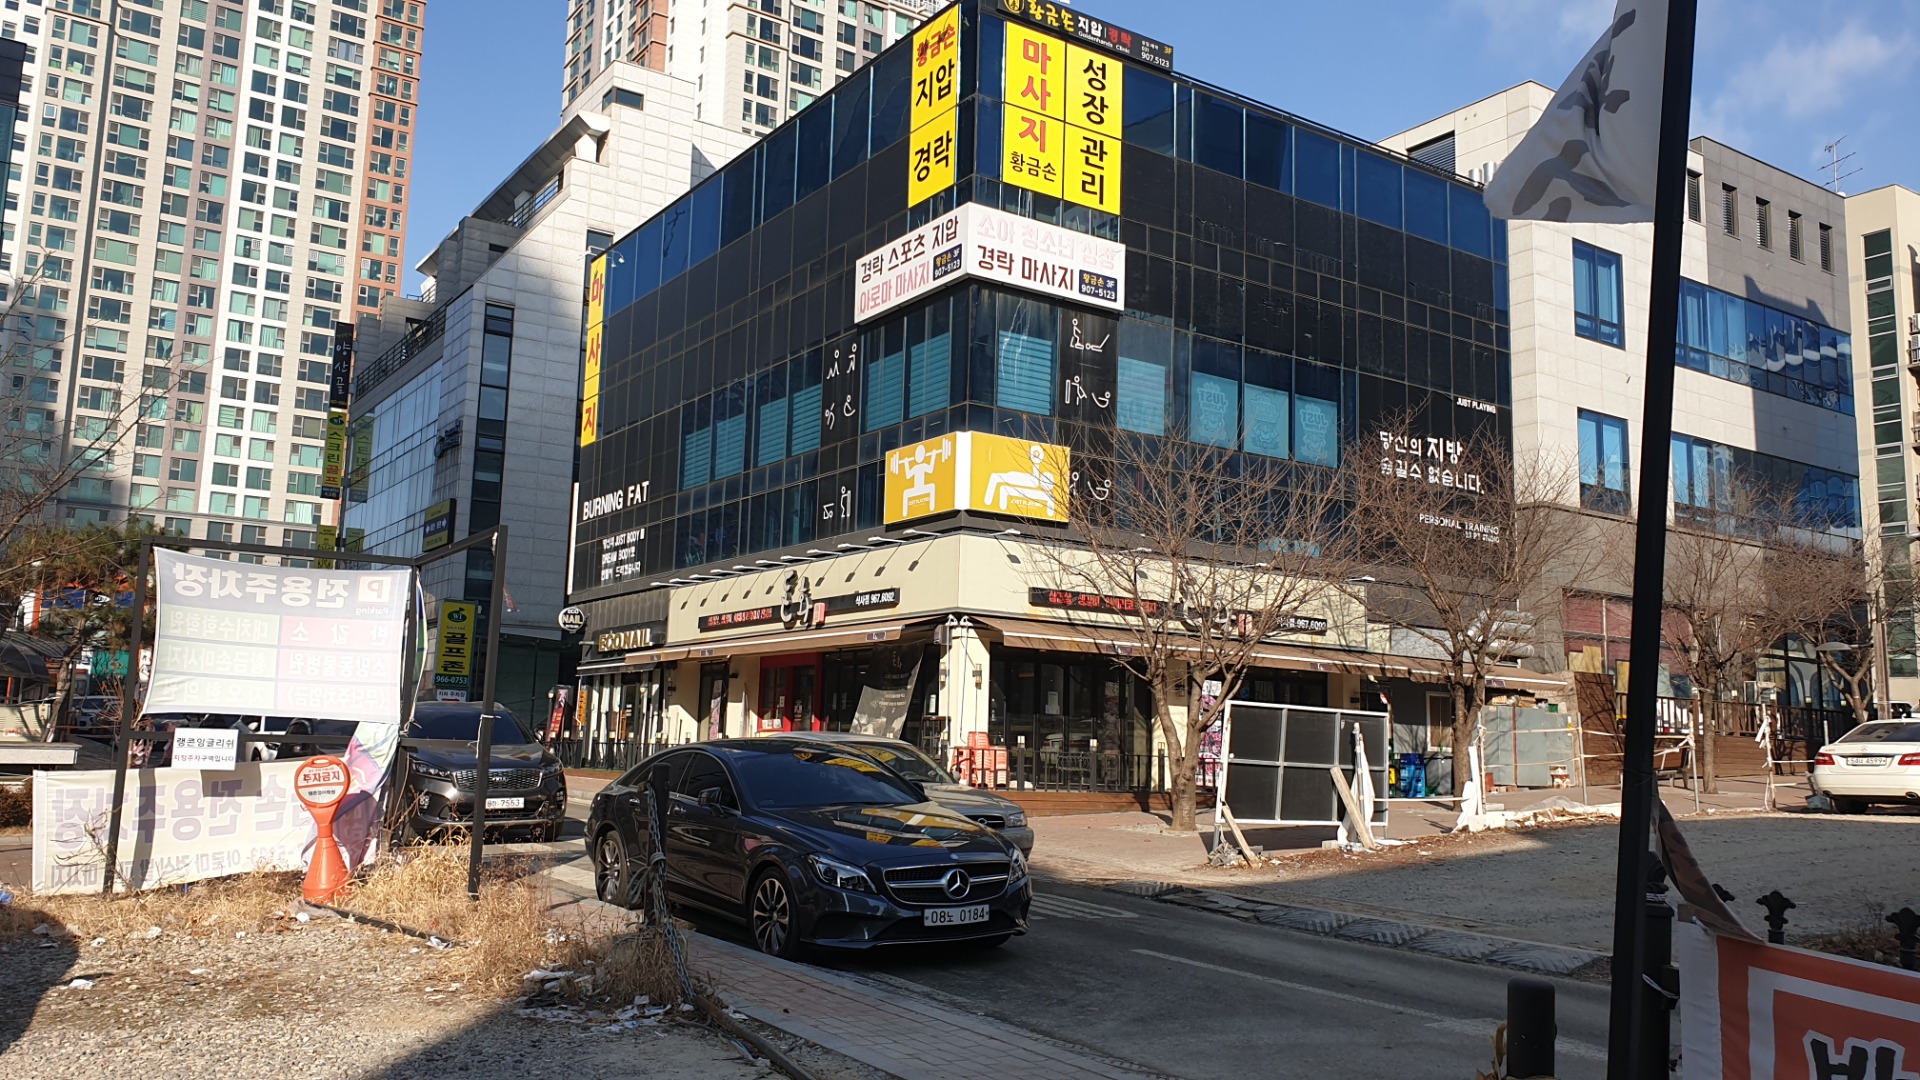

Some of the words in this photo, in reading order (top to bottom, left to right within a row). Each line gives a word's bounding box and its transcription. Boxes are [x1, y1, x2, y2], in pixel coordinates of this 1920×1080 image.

[915, 23, 956, 67] 황금손
[1078, 15, 1103, 37] 지압
[1108, 27, 1132, 47] 경락
[1141, 51, 1170, 68] 907.5123
[914, 59, 954, 108] 지압
[1019, 38, 1051, 153] 마사지
[913, 130, 953, 182] 경락
[1009, 151, 1057, 183] 황금손
[861, 253, 884, 284] 경락
[888, 233, 925, 272] 스포츠
[932, 215, 959, 249] 지압
[977, 214, 1016, 244] 소아
[1022, 225, 1074, 260] 청소년
[977, 245, 1014, 275] 경락
[1021, 256, 1074, 291] 마사지
[1083, 273, 1104, 288] 황금손
[860, 279, 892, 314] 아로마
[895, 260, 930, 298] 마사지
[1081, 284, 1115, 300] 907-5123
[583, 276, 604, 437] 마사지
[1457, 398, 1471, 407] JUST
[325, 431, 343, 486] 스크린골프
[1379, 431, 1422, 457] 당신의
[1427, 437, 1463, 464] 지방
[583, 489, 624, 520] BURNING
[627, 480, 649, 506] FAT
[615, 533, 626, 547] JUST
[1419, 513, 1461, 529] PERSONAL
[1464, 521, 1499, 535] TRAINING
[563, 614, 582, 624] NAIL
[441, 632, 468, 673] 골프존
[435, 675, 467, 684] 966-0753
[174, 754, 234, 762] 지정주차구역입니다
[176, 737, 234, 748] 랭콘잉글리쉬
[303, 771, 340, 783] 주차금지
[500, 798, 520, 807] 7553
[931, 910, 954, 923] 08노
[959, 907, 985, 922] 0184
